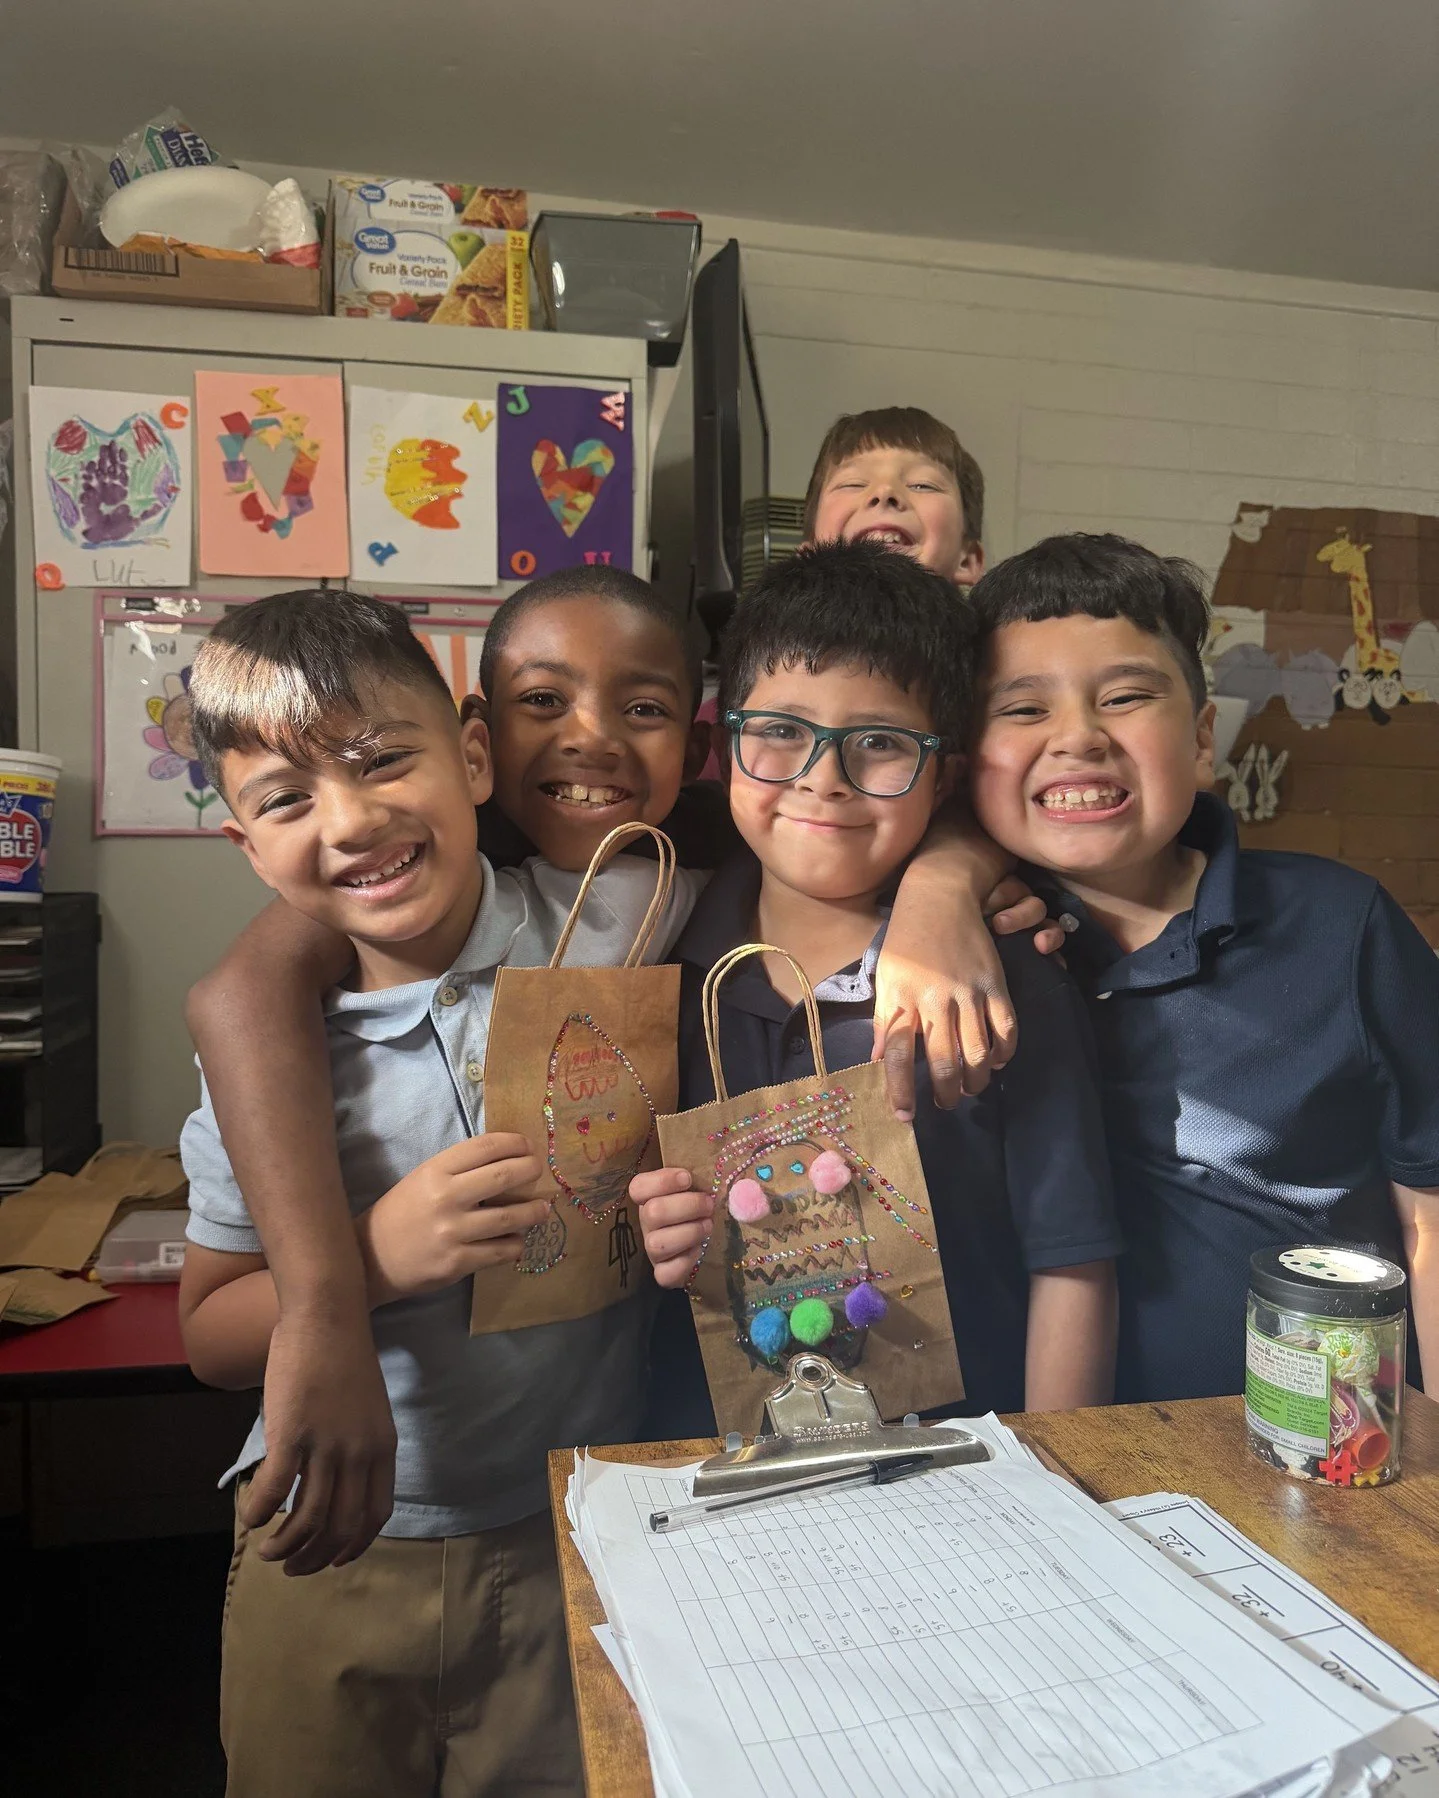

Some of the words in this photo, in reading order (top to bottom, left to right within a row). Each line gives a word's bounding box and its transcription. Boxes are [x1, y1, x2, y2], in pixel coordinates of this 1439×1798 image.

[389, 198, 408, 208] Fruit
[410, 200, 416, 208] &
[418, 201, 444, 211] Grain
[360, 232, 389, 244] Great
[365, 240, 389, 250] Value
[397, 254, 426, 264] Variety
[427, 256, 447, 264] Pack
[369, 262, 396, 276] Fruit
[400, 266, 409, 276] &
[410, 266, 448, 280] Grain
[512, 262, 525, 296] PACK
[506, 386, 530, 414] J
[160, 402, 189, 430] C
[510, 550, 536, 576] O
[1280, 1438, 1297, 1446] SMALL
[1298, 1442, 1326, 1452] CHILDREN
[1000, 1512, 1015, 1525] MONDAY
[1159, 1534, 1185, 1548] 23
[1051, 1562, 1070, 1580] TUESDAY
[1232, 1592, 1261, 1609] 32
[1107, 1619, 1133, 1642] WEDNESDAY
[1179, 1680, 1206, 1704] THURSDAY
